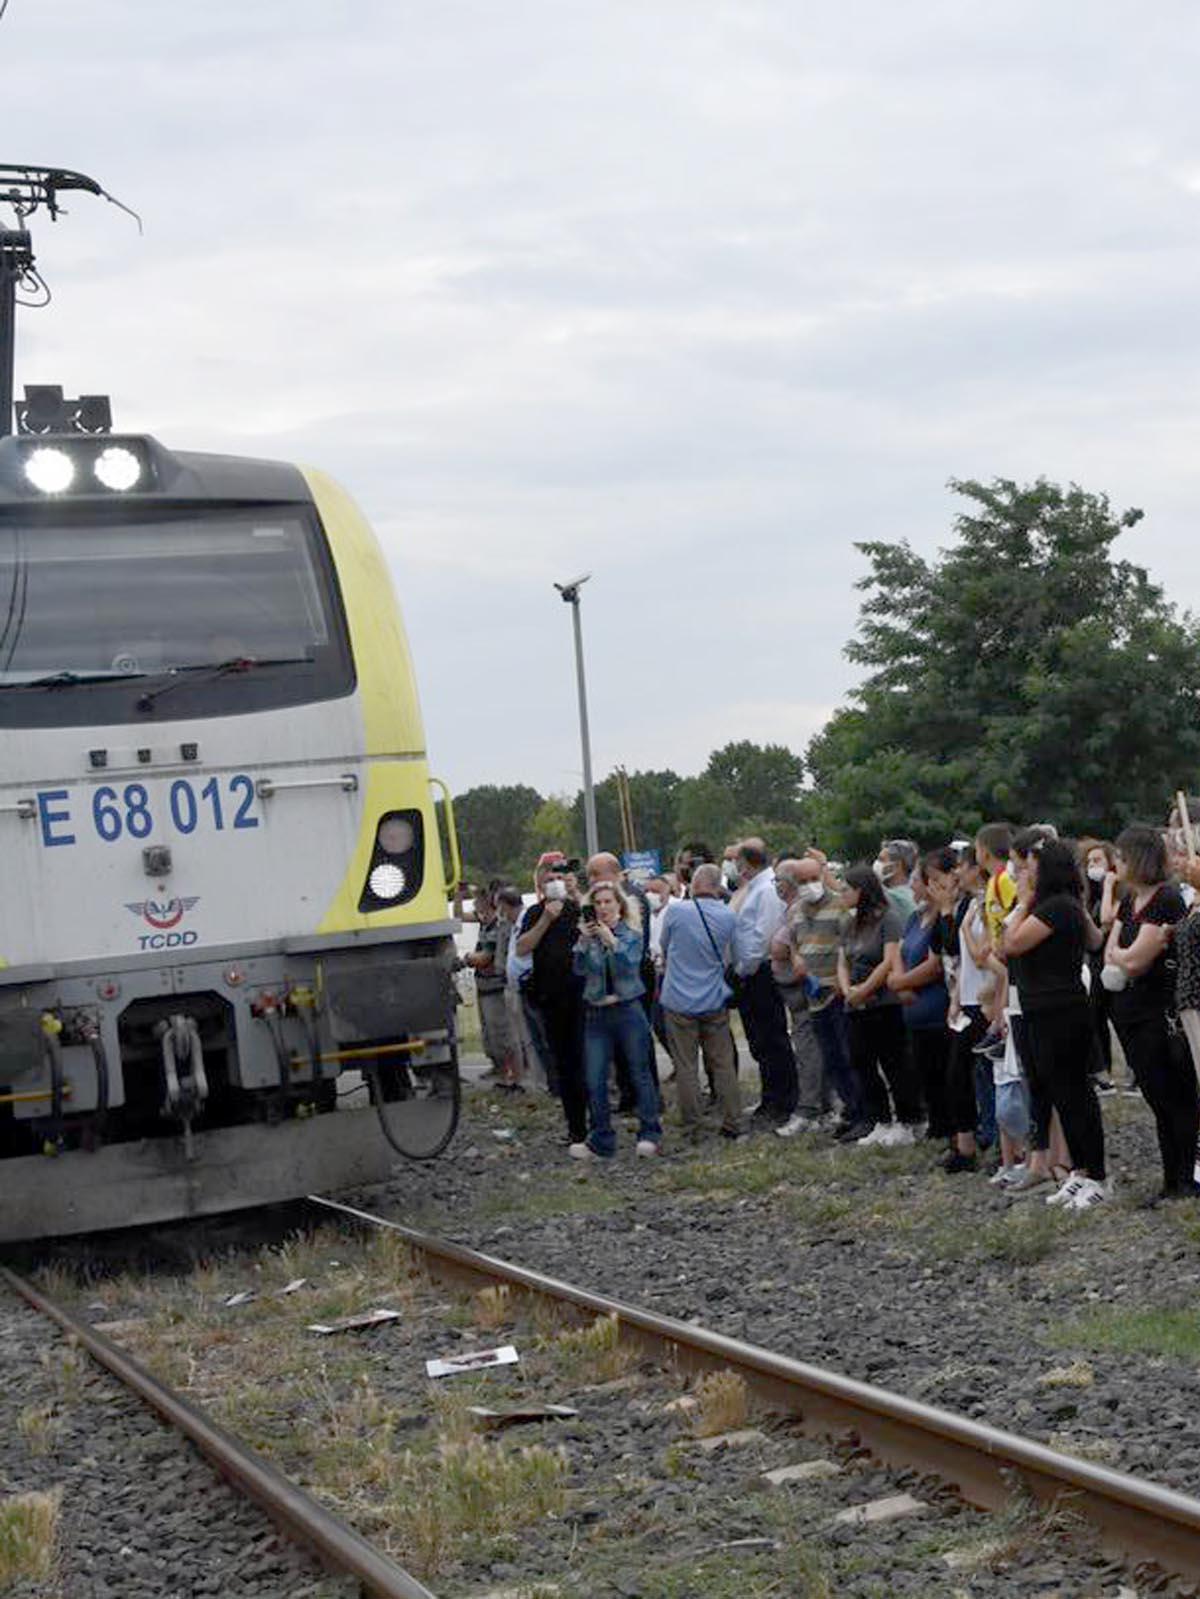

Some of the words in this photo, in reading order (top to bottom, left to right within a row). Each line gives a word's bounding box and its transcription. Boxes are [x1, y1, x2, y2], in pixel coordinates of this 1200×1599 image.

[36, 790, 75, 848] E
[92, 783, 153, 842] 68
[169, 774, 260, 835] 012
[137, 930, 198, 950] TCDD
